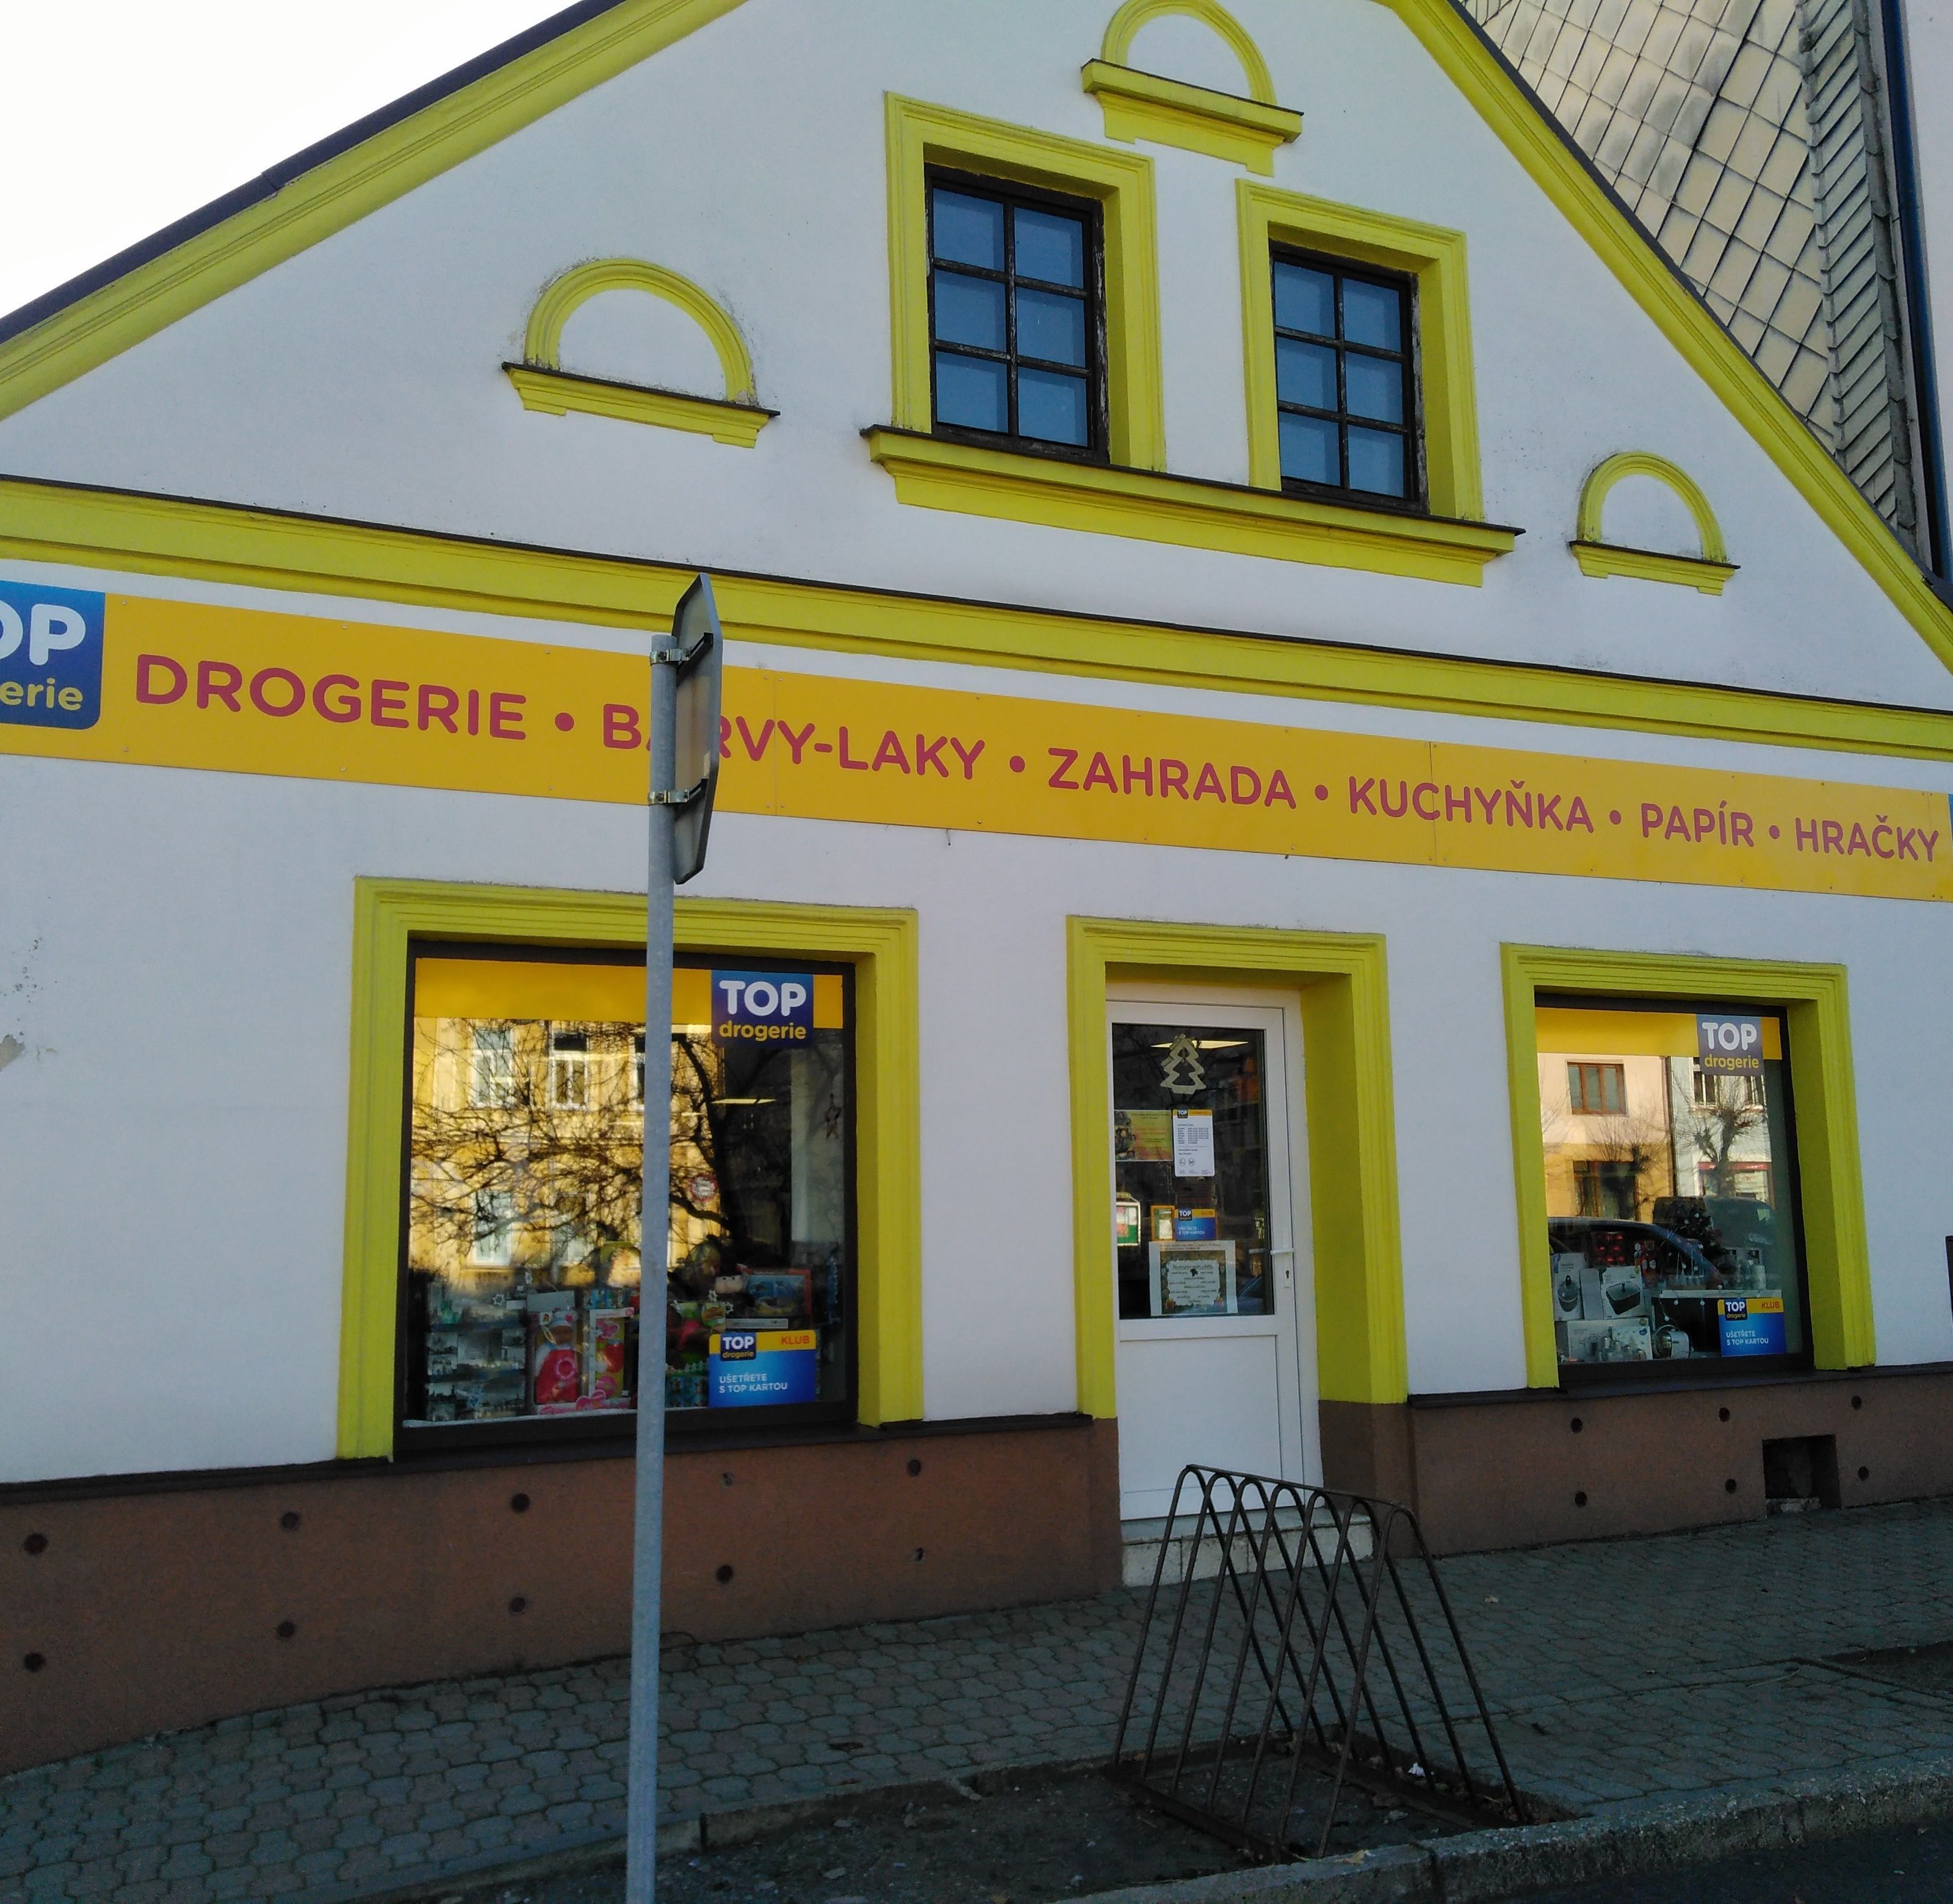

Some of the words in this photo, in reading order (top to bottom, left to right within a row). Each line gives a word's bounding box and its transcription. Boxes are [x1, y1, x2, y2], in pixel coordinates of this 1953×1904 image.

[135, 654, 527, 740] DROGERIE
[603, 703, 985, 780] BVY-LAKY
[1048, 748, 1297, 809] ZAHRADA
[1348, 776, 1594, 834] KUCHYŇKA
[1641, 800, 1754, 847] PAPÍR
[1794, 814, 1940, 862] HRAČKY
[719, 980, 807, 1017] TOP
[719, 1020, 807, 1042] drogerie
[1702, 1022, 1757, 1051] TOP
[1704, 1054, 1759, 1070] drogerie
[1725, 1302, 1745, 1312] TOP
[723, 1336, 754, 1350] TOP
[781, 1335, 810, 1345] KLUB
[723, 1350, 754, 1359] drogerie
[720, 1373, 767, 1383] UŠETŘETE
[728, 1384, 748, 1393] TOP
[749, 1382, 788, 1391] KARTOU
